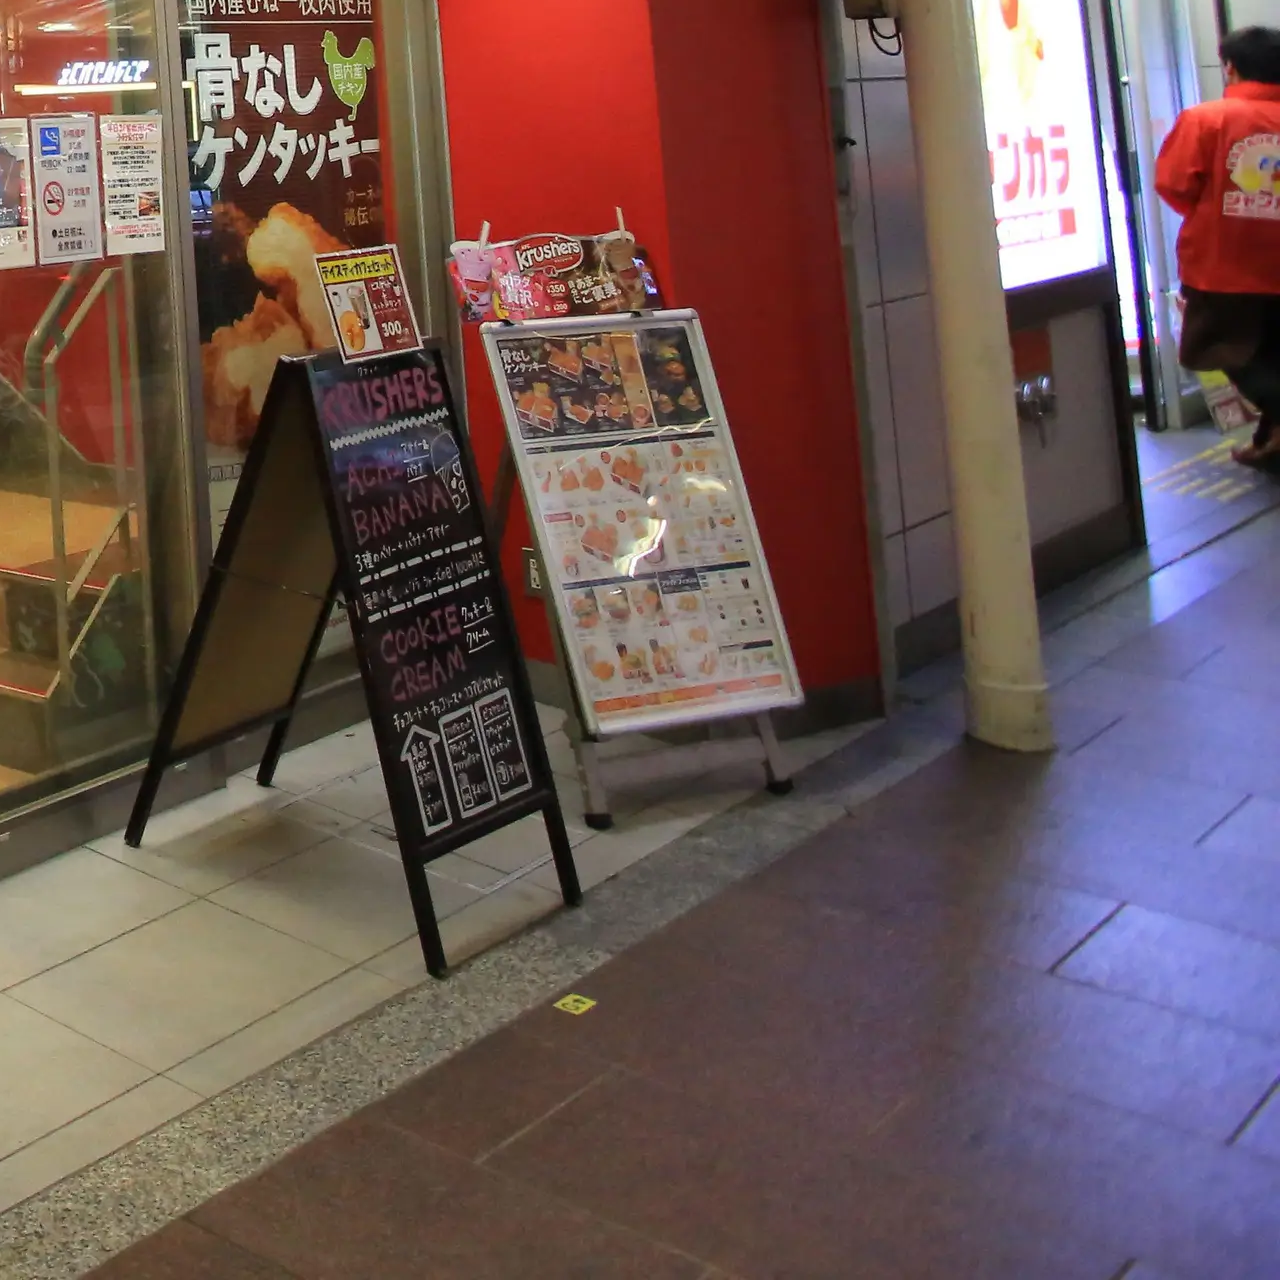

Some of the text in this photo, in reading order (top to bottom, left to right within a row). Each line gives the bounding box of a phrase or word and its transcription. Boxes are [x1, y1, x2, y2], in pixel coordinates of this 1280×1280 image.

[185, 32, 323, 121] 骨なし
[332, 63, 364, 80] 国内産
[338, 81, 363, 96] チキン
[191, 118, 380, 192] ケンタッキー
[350, 480, 450, 547] BANANA
[390, 643, 467, 702] CREAM
